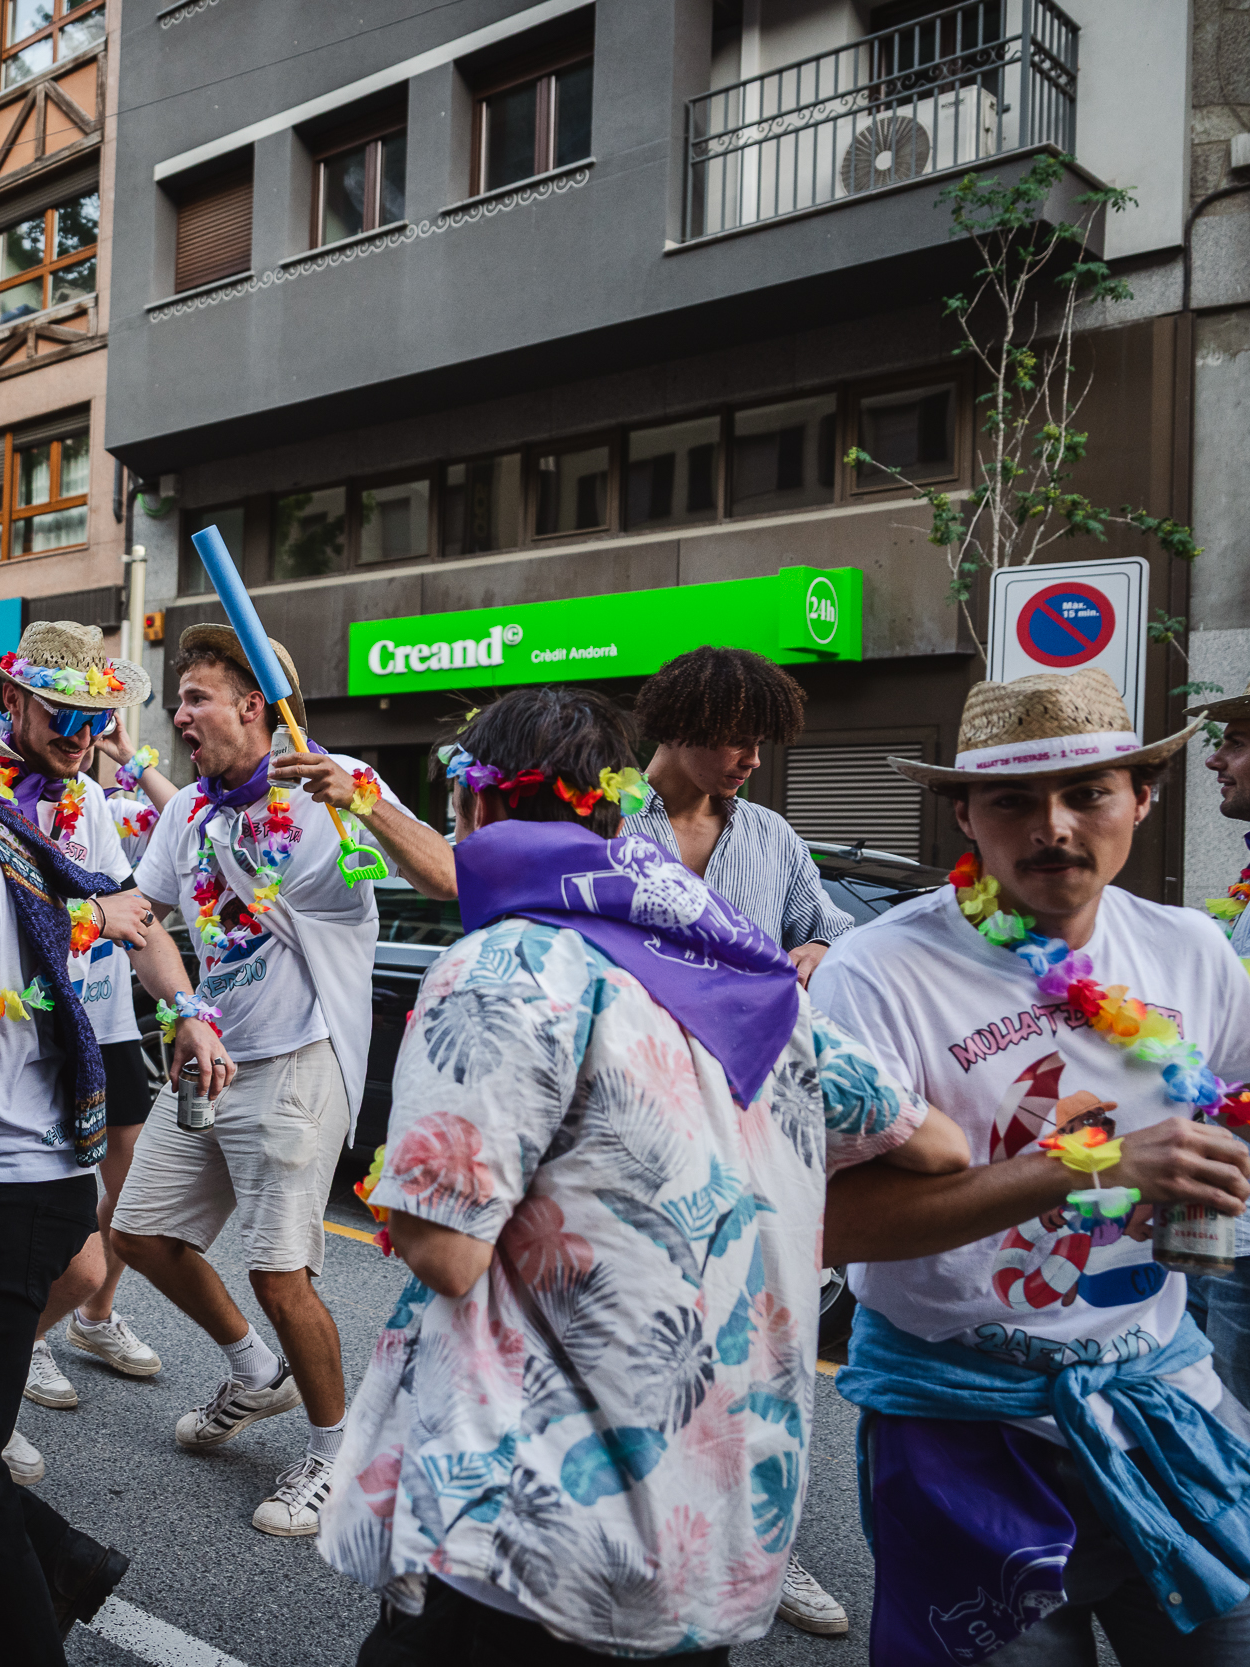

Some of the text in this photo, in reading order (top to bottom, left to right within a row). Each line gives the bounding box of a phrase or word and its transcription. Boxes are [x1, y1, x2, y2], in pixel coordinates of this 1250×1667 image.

[810, 595, 835, 622] 24h
[1062, 609, 1100, 618] 15 min.
[531, 649, 566, 664] Crèdit
[569, 643, 618, 660] Andorrà
